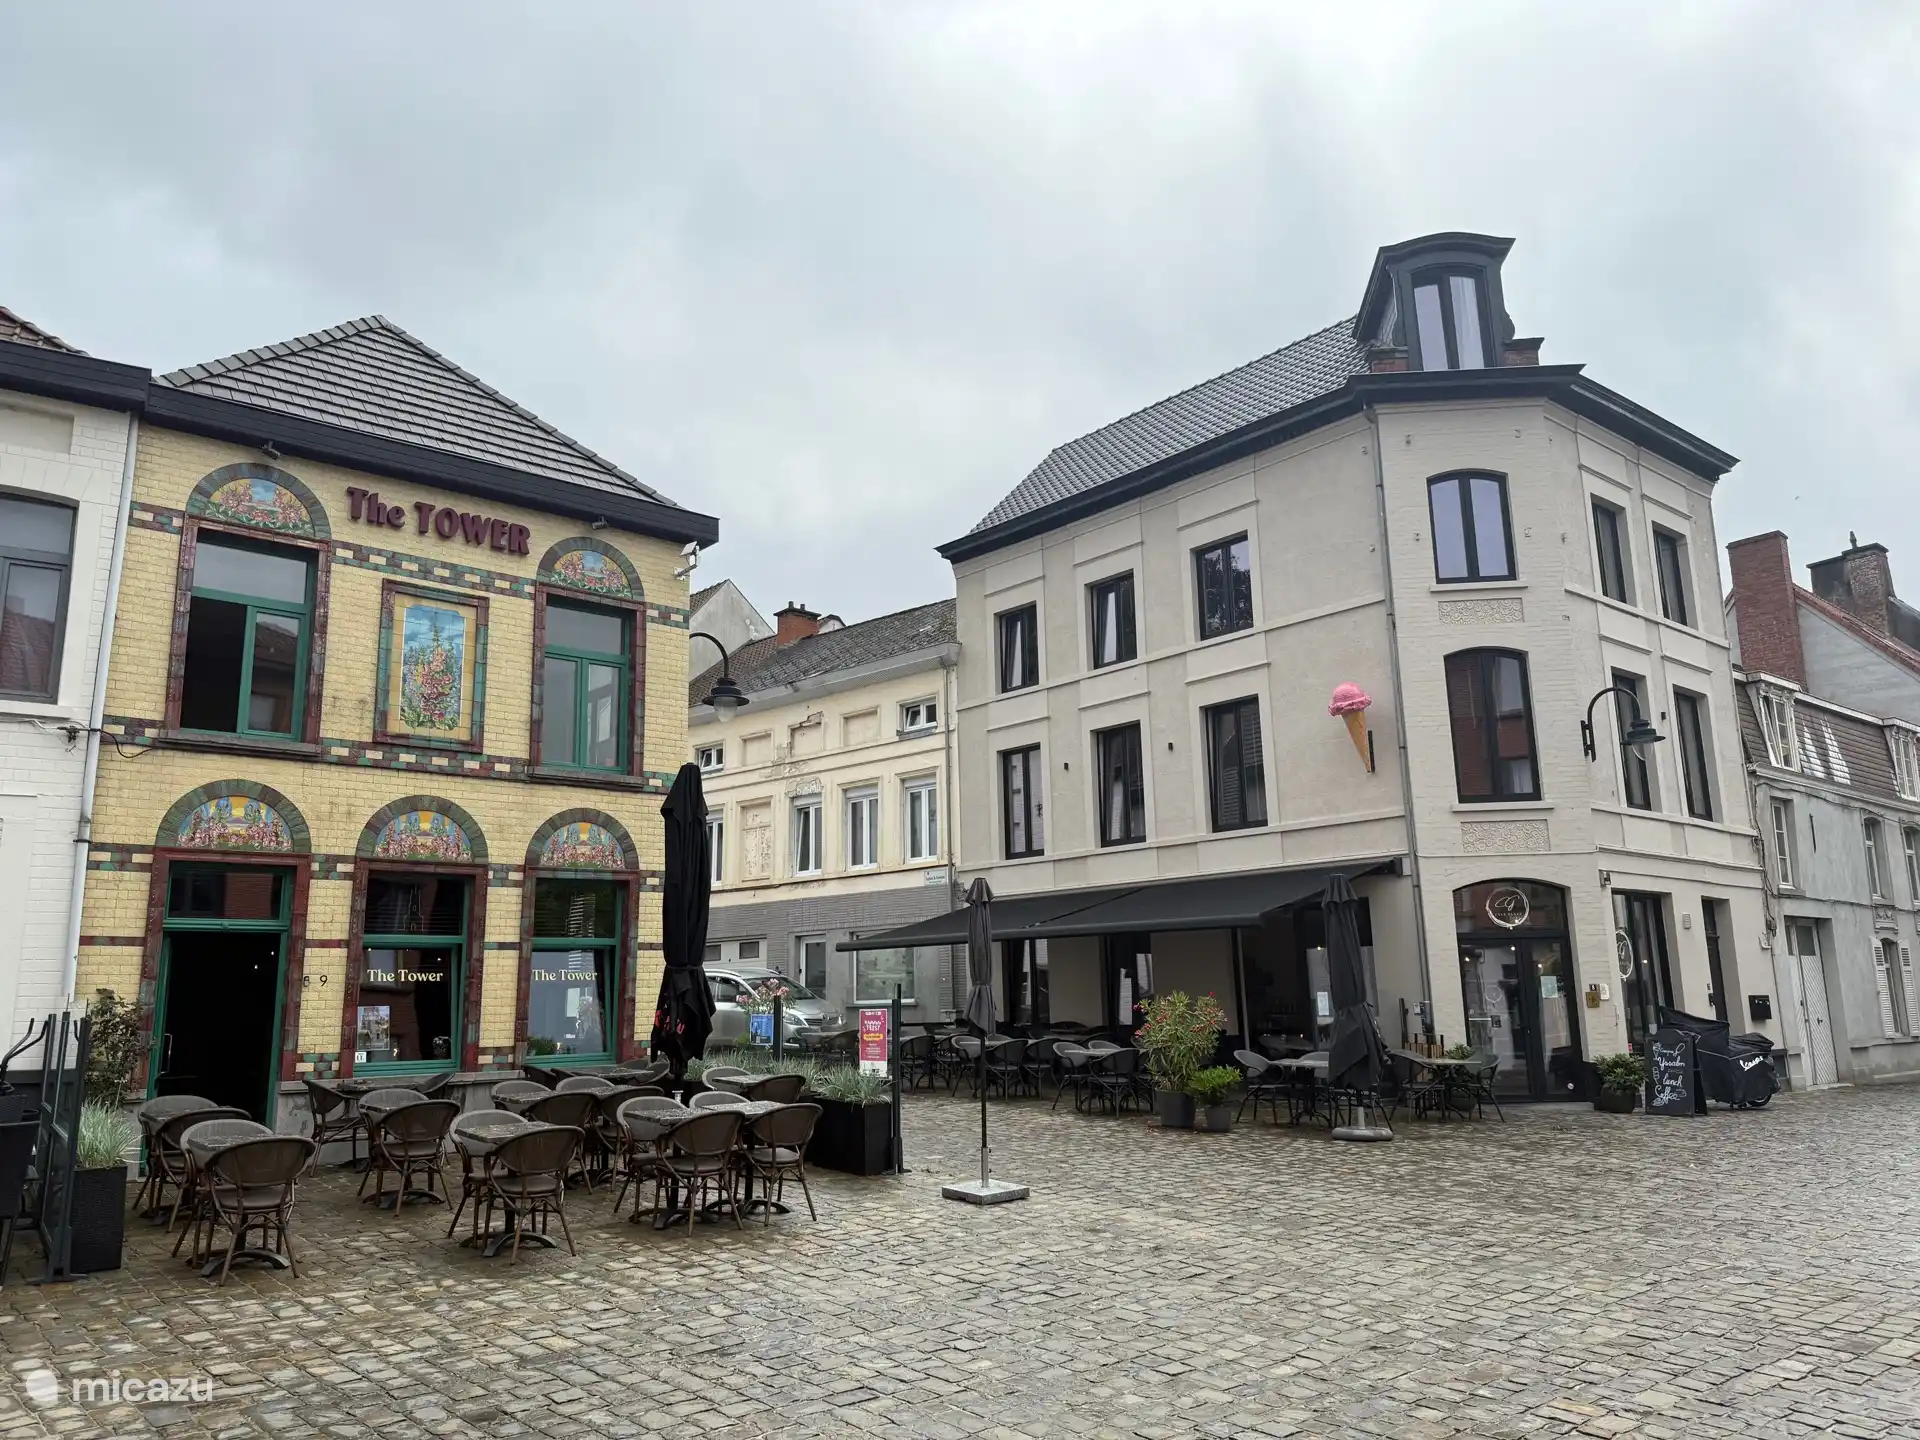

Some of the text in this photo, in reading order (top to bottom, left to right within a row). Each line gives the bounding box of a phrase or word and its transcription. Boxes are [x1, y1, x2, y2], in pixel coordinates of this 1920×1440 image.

[346, 487, 532, 555] The TOWER
[319, 975, 328, 987] 9
[367, 969, 444, 982] The Tower
[533, 969, 598, 981] The Tower
